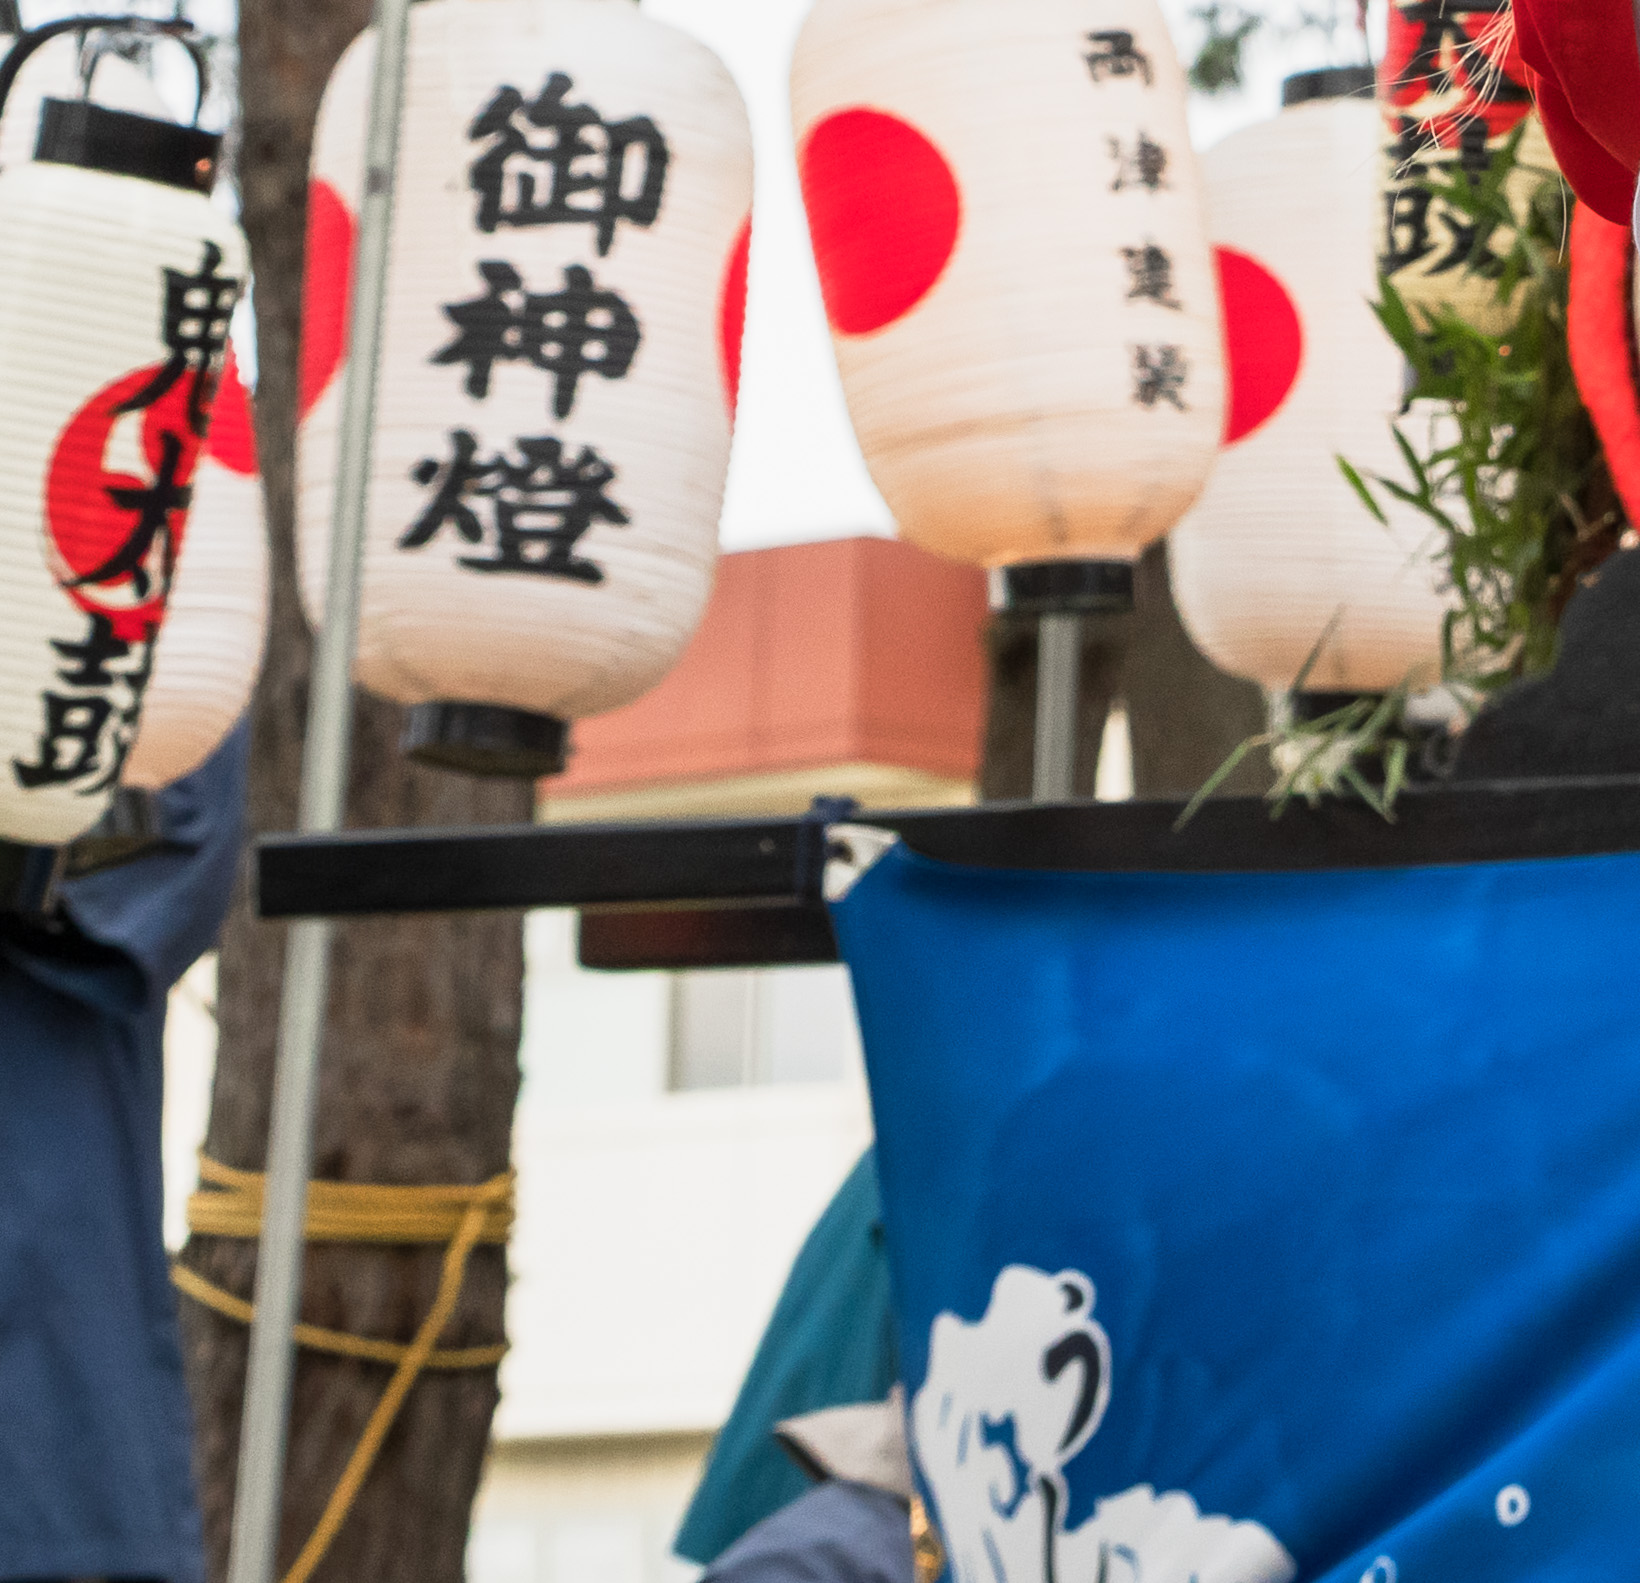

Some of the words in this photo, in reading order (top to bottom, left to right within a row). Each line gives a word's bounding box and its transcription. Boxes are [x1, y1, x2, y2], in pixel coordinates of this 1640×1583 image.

[12, 239, 239, 794] 鬼太鼓
[400, 71, 669, 585] 御神燈
